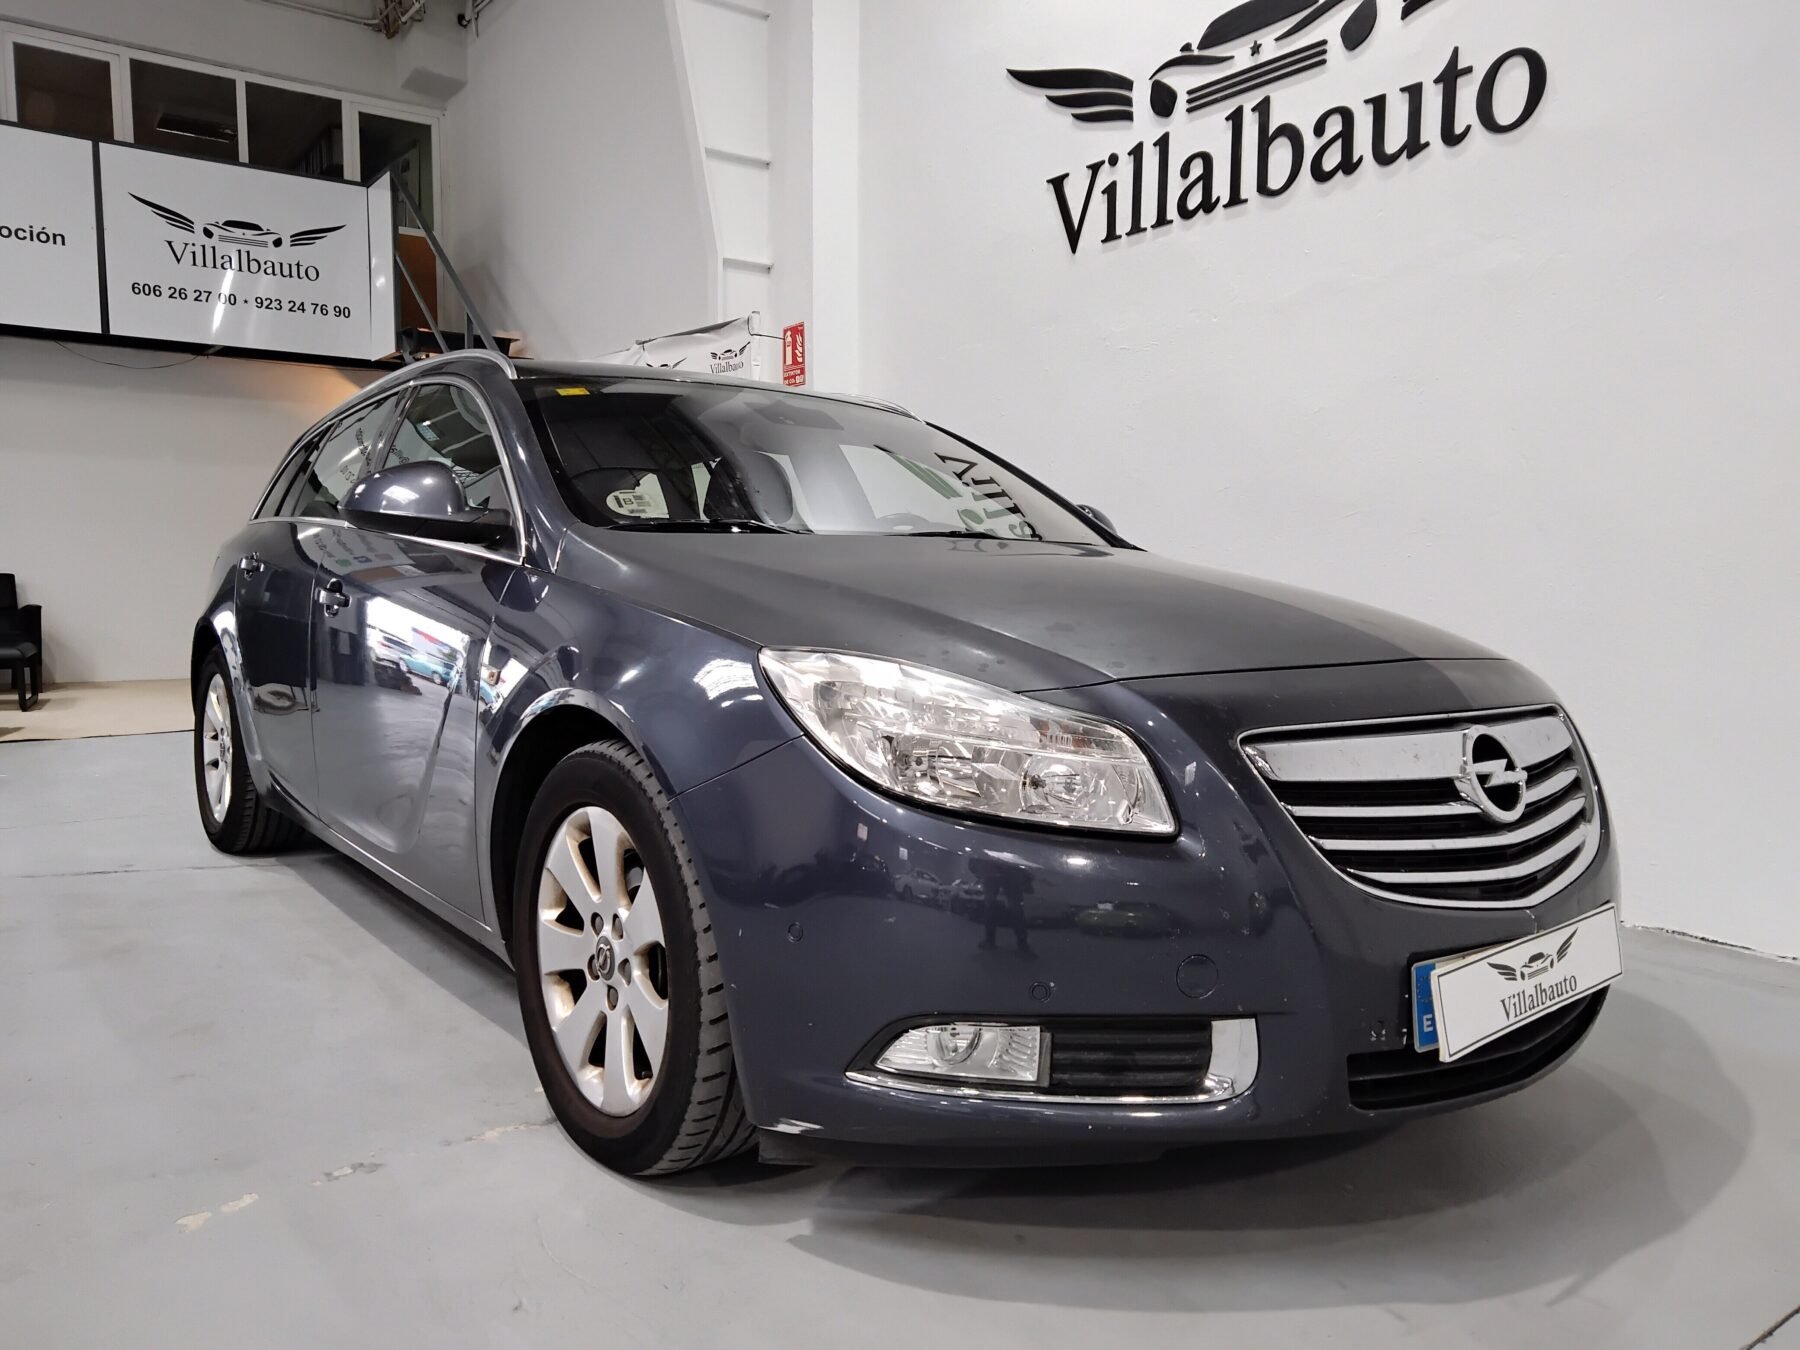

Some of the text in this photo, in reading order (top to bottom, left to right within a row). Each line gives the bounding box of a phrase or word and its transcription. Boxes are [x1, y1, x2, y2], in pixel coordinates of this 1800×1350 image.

[1047, 46, 1548, 254] Villalbauto
[164, 239, 320, 282] Villalbauto
[131, 282, 351, 319] 606 26 27 00 923 24 76 90
[1500, 974, 1578, 1022] Villalbauto
[1423, 1013, 1434, 1033] E
